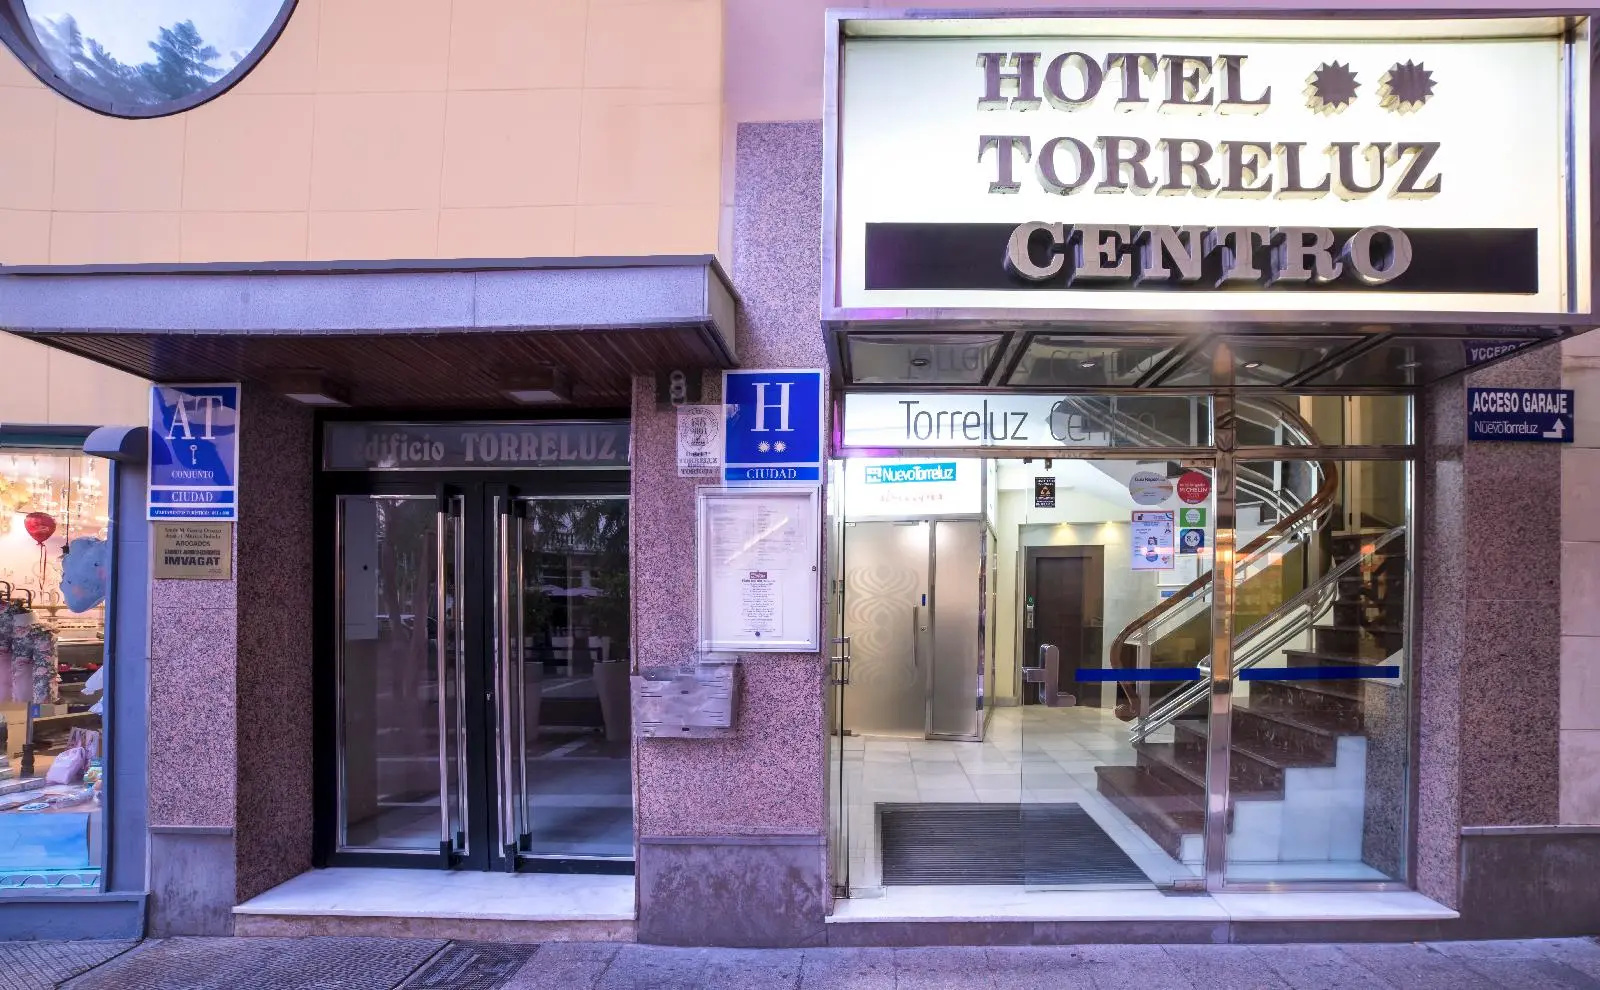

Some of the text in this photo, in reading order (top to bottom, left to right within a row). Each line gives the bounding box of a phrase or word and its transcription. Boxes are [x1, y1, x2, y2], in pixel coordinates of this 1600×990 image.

[976, 52, 1271, 116] HOTEL
[977, 135, 1443, 200] TORRELUZ
[1004, 221, 1413, 288] CENTRO
[750, 382, 795, 432] H
[1472, 391, 1568, 414] ACCESO GARAJE
[165, 394, 223, 440] AT
[898, 399, 1029, 441] Torreluz
[1474, 420, 1538, 434] NuevoTorreluz
[460, 432, 617, 462] TORRELUZ
[171, 470, 214, 479] CONJUNTO
[746, 468, 797, 480] CIUDAD
[882, 464, 954, 482] NuevoTorreluz
[171, 491, 213, 502] CIUDAD
[164, 556, 221, 566] IMVAGAT
